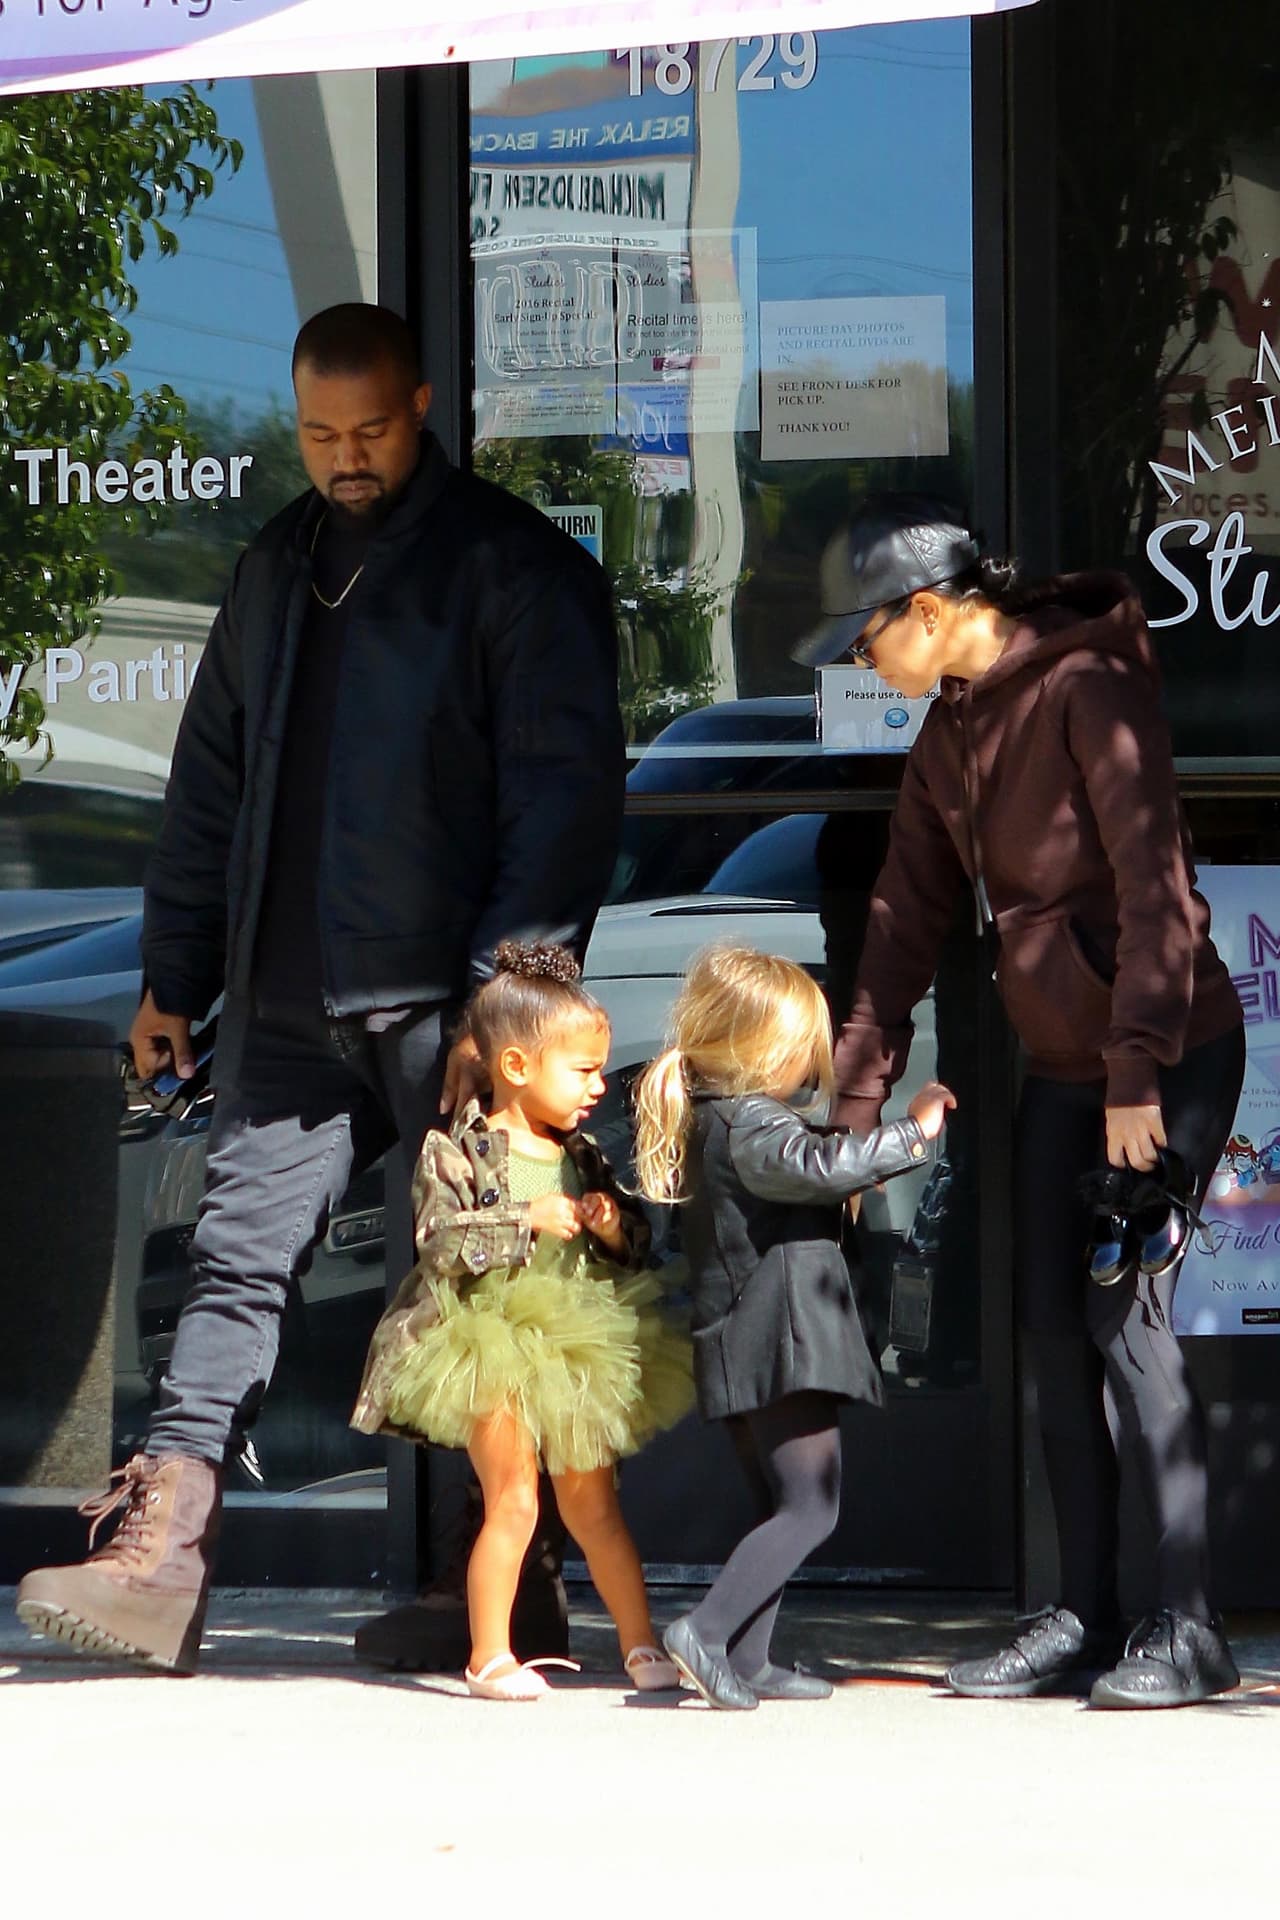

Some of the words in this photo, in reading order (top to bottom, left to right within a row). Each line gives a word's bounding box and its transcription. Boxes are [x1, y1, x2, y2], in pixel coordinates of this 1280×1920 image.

[615, 32, 818, 97] 18729
[515, 298, 540, 309] 2016
[627, 313, 669, 327] Recital
[672, 313, 698, 326] time
[777, 325, 829, 337] PICTURE
[831, 323, 853, 335] DAY
[856, 321, 905, 334] PHOTOS
[777, 340, 803, 350] AND
[806, 337, 856, 349] RECITAL
[892, 335, 914, 346] ARE
[777, 381, 799, 392] SEE
[802, 379, 842, 391] FRONT
[845, 378, 876, 390] DESK
[878, 377, 901, 389] FOR
[777, 395, 804, 406] PICK
[806, 394, 825, 406] UP.
[777, 421, 820, 433] THANK
[822, 420, 850, 432] YOU!
[13, 445, 254, 506] Theater
[845, 690, 876, 700] Please
[878, 691, 895, 700] use
[1195, 1218, 1269, 1258] Find
